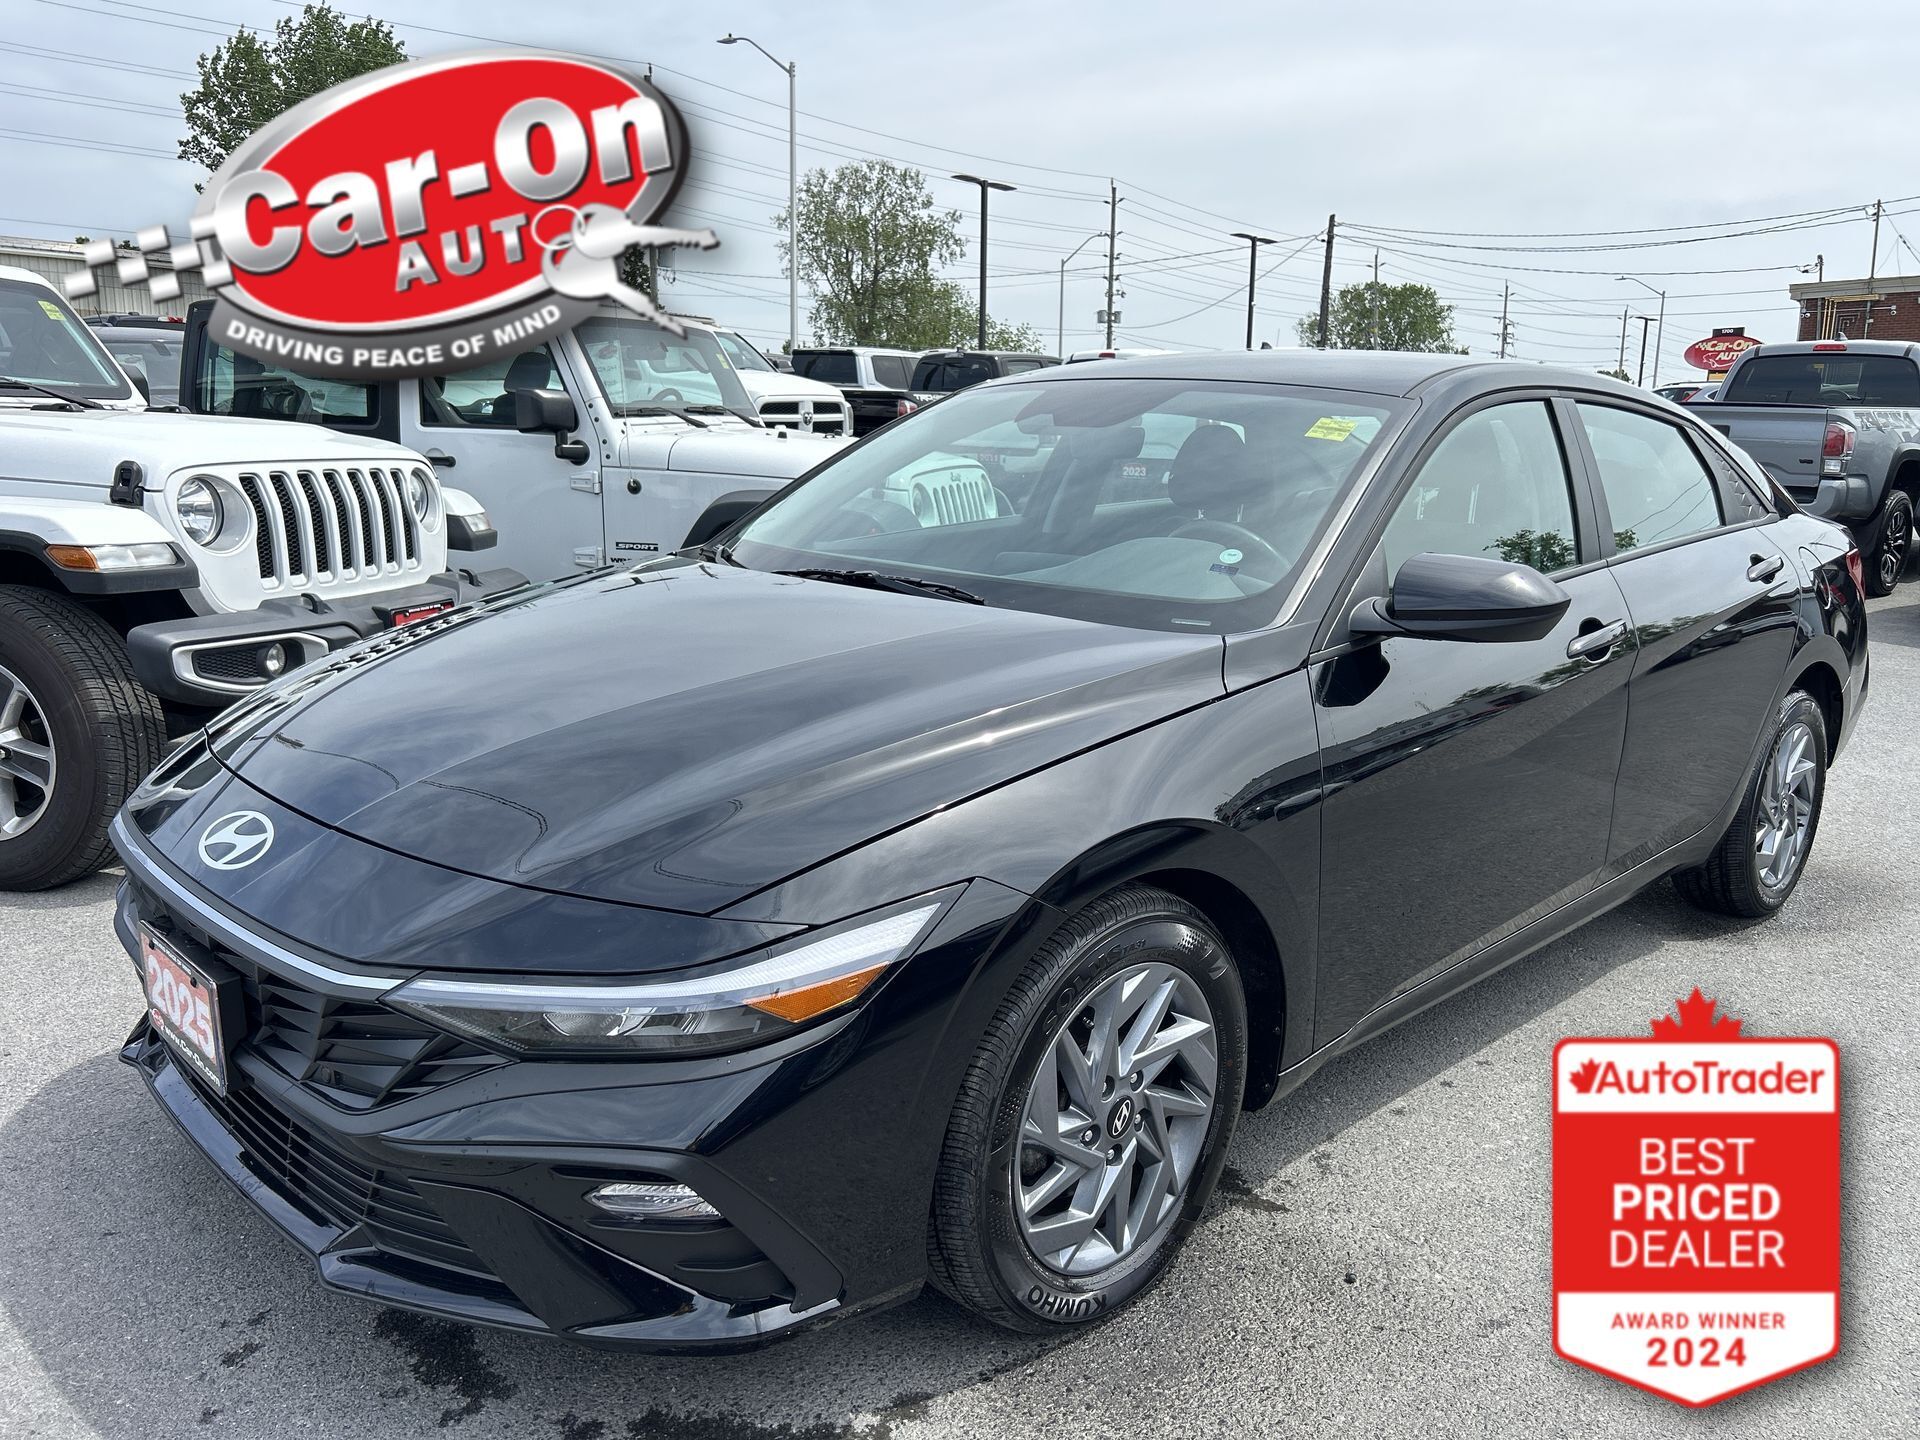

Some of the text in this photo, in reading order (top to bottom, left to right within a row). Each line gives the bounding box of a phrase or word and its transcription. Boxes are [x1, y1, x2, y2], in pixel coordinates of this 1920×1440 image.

[1707, 339, 1754, 352] Car-On
[1715, 351, 1741, 361] AUT
[1122, 466, 1146, 477] 2023
[618, 543, 657, 551] SPORT
[147, 953, 216, 1061] 2025
[1027, 1284, 1107, 1317] KUMHO
